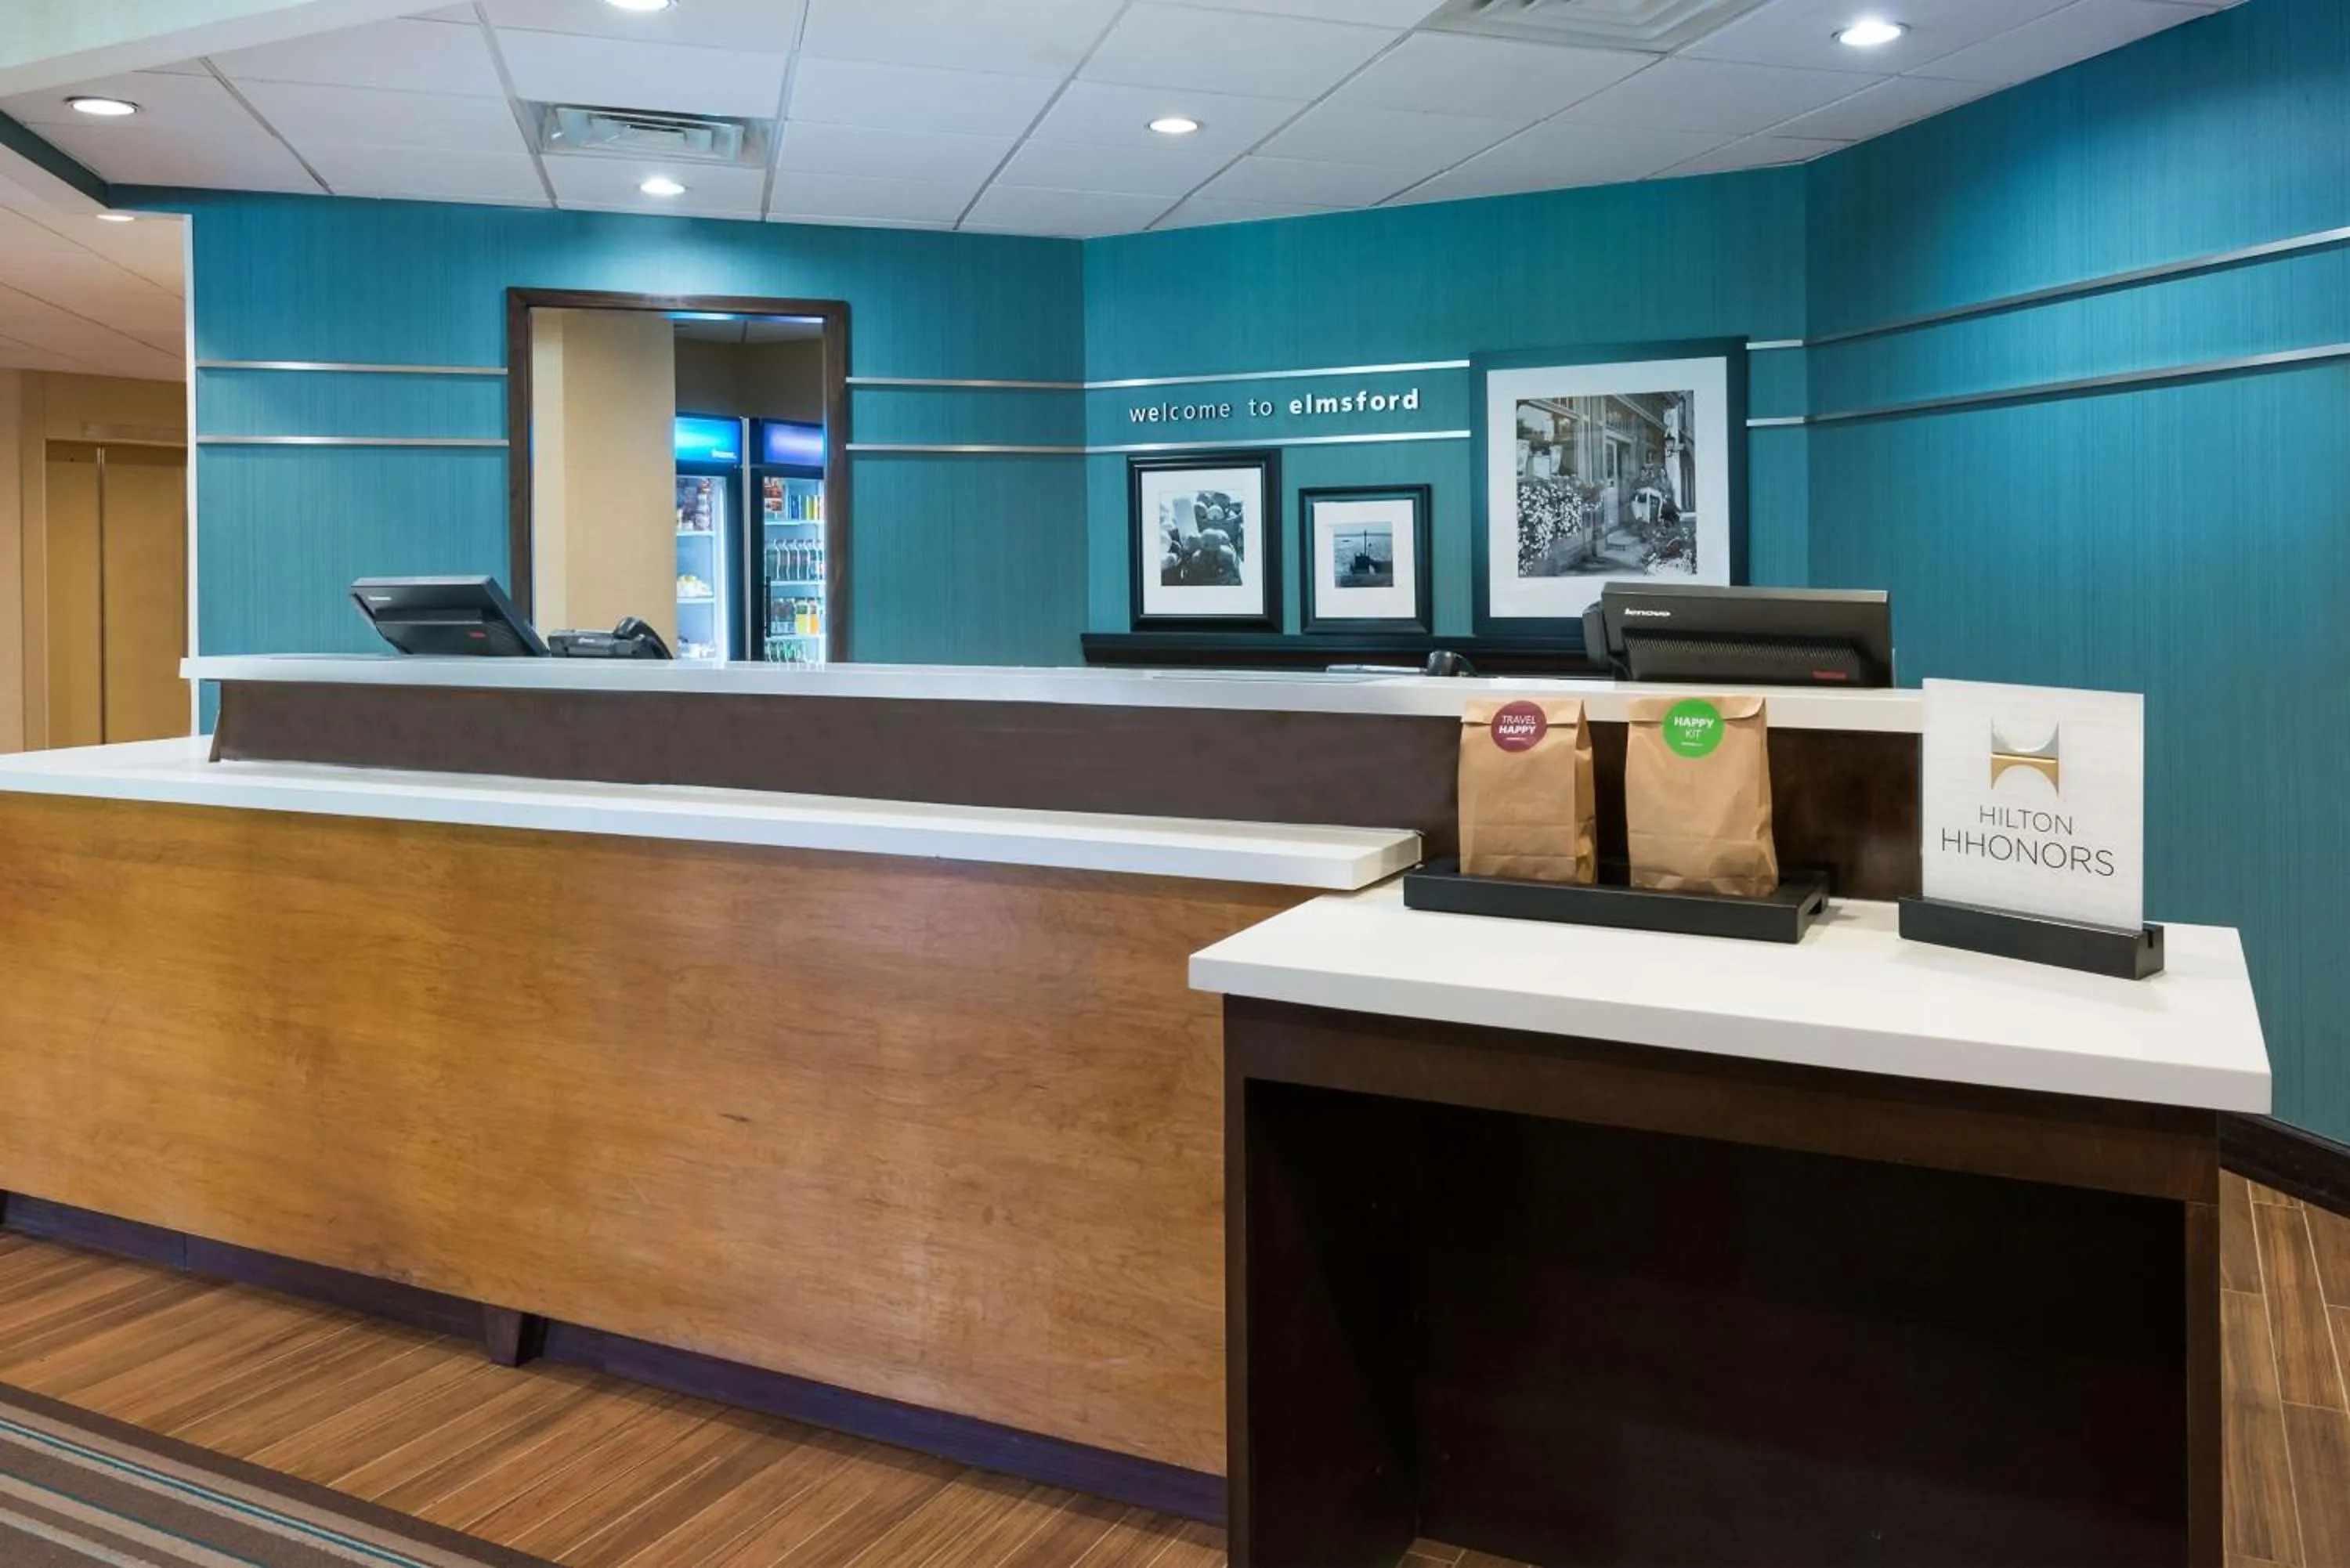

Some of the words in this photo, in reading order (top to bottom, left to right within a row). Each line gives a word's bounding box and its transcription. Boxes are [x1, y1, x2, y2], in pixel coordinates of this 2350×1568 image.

[1130, 402, 1231, 422] welcome
[1249, 399, 1274, 417] to
[1289, 388, 1419, 414] elmsford
[1625, 607, 1671, 616] lenovo
[1501, 714, 1536, 724] TRAVEL
[1674, 716, 1715, 728] HAPPY
[1499, 724, 1536, 734] HAPPY
[1685, 729, 1702, 739] KIT
[1979, 805, 2072, 836] HILTON
[1942, 828, 2115, 876] HHONORS
